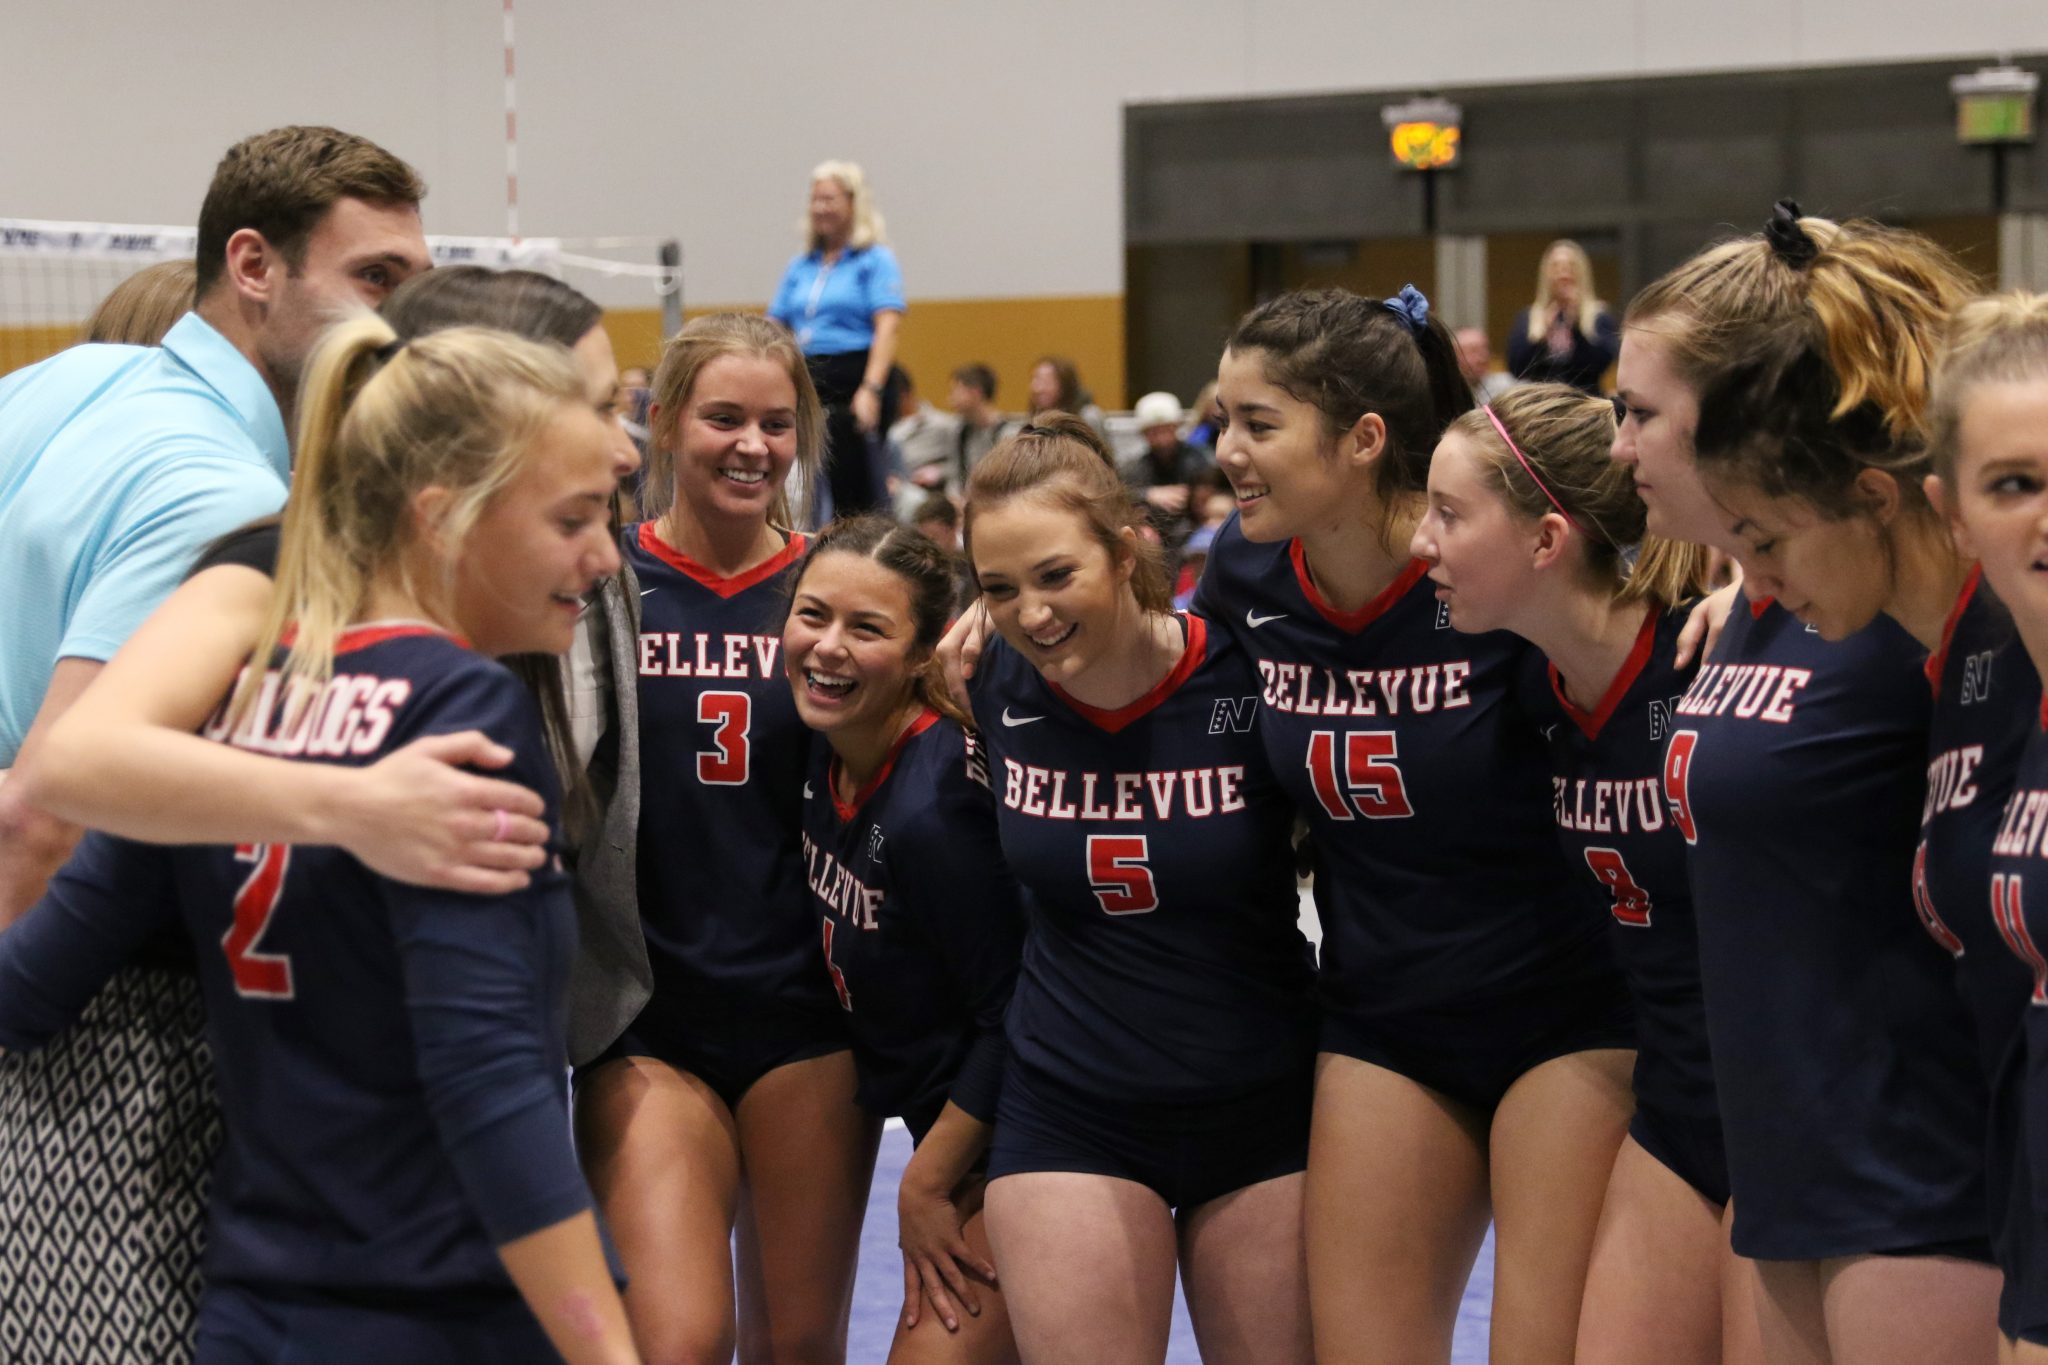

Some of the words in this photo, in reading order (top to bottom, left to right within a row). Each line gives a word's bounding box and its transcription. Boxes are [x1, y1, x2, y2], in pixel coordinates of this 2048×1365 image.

[638, 632, 787, 679] ELLEV
[1257, 658, 1471, 717] BELLEVUE
[1676, 663, 1813, 724] LLEVUE
[696, 690, 751, 786] 3
[1003, 757, 1247, 821] BELLEVUE
[1305, 730, 1414, 821] 15
[1552, 776, 1664, 833] LLEVU
[1086, 834, 1159, 916] 5
[220, 843, 296, 999] 2
